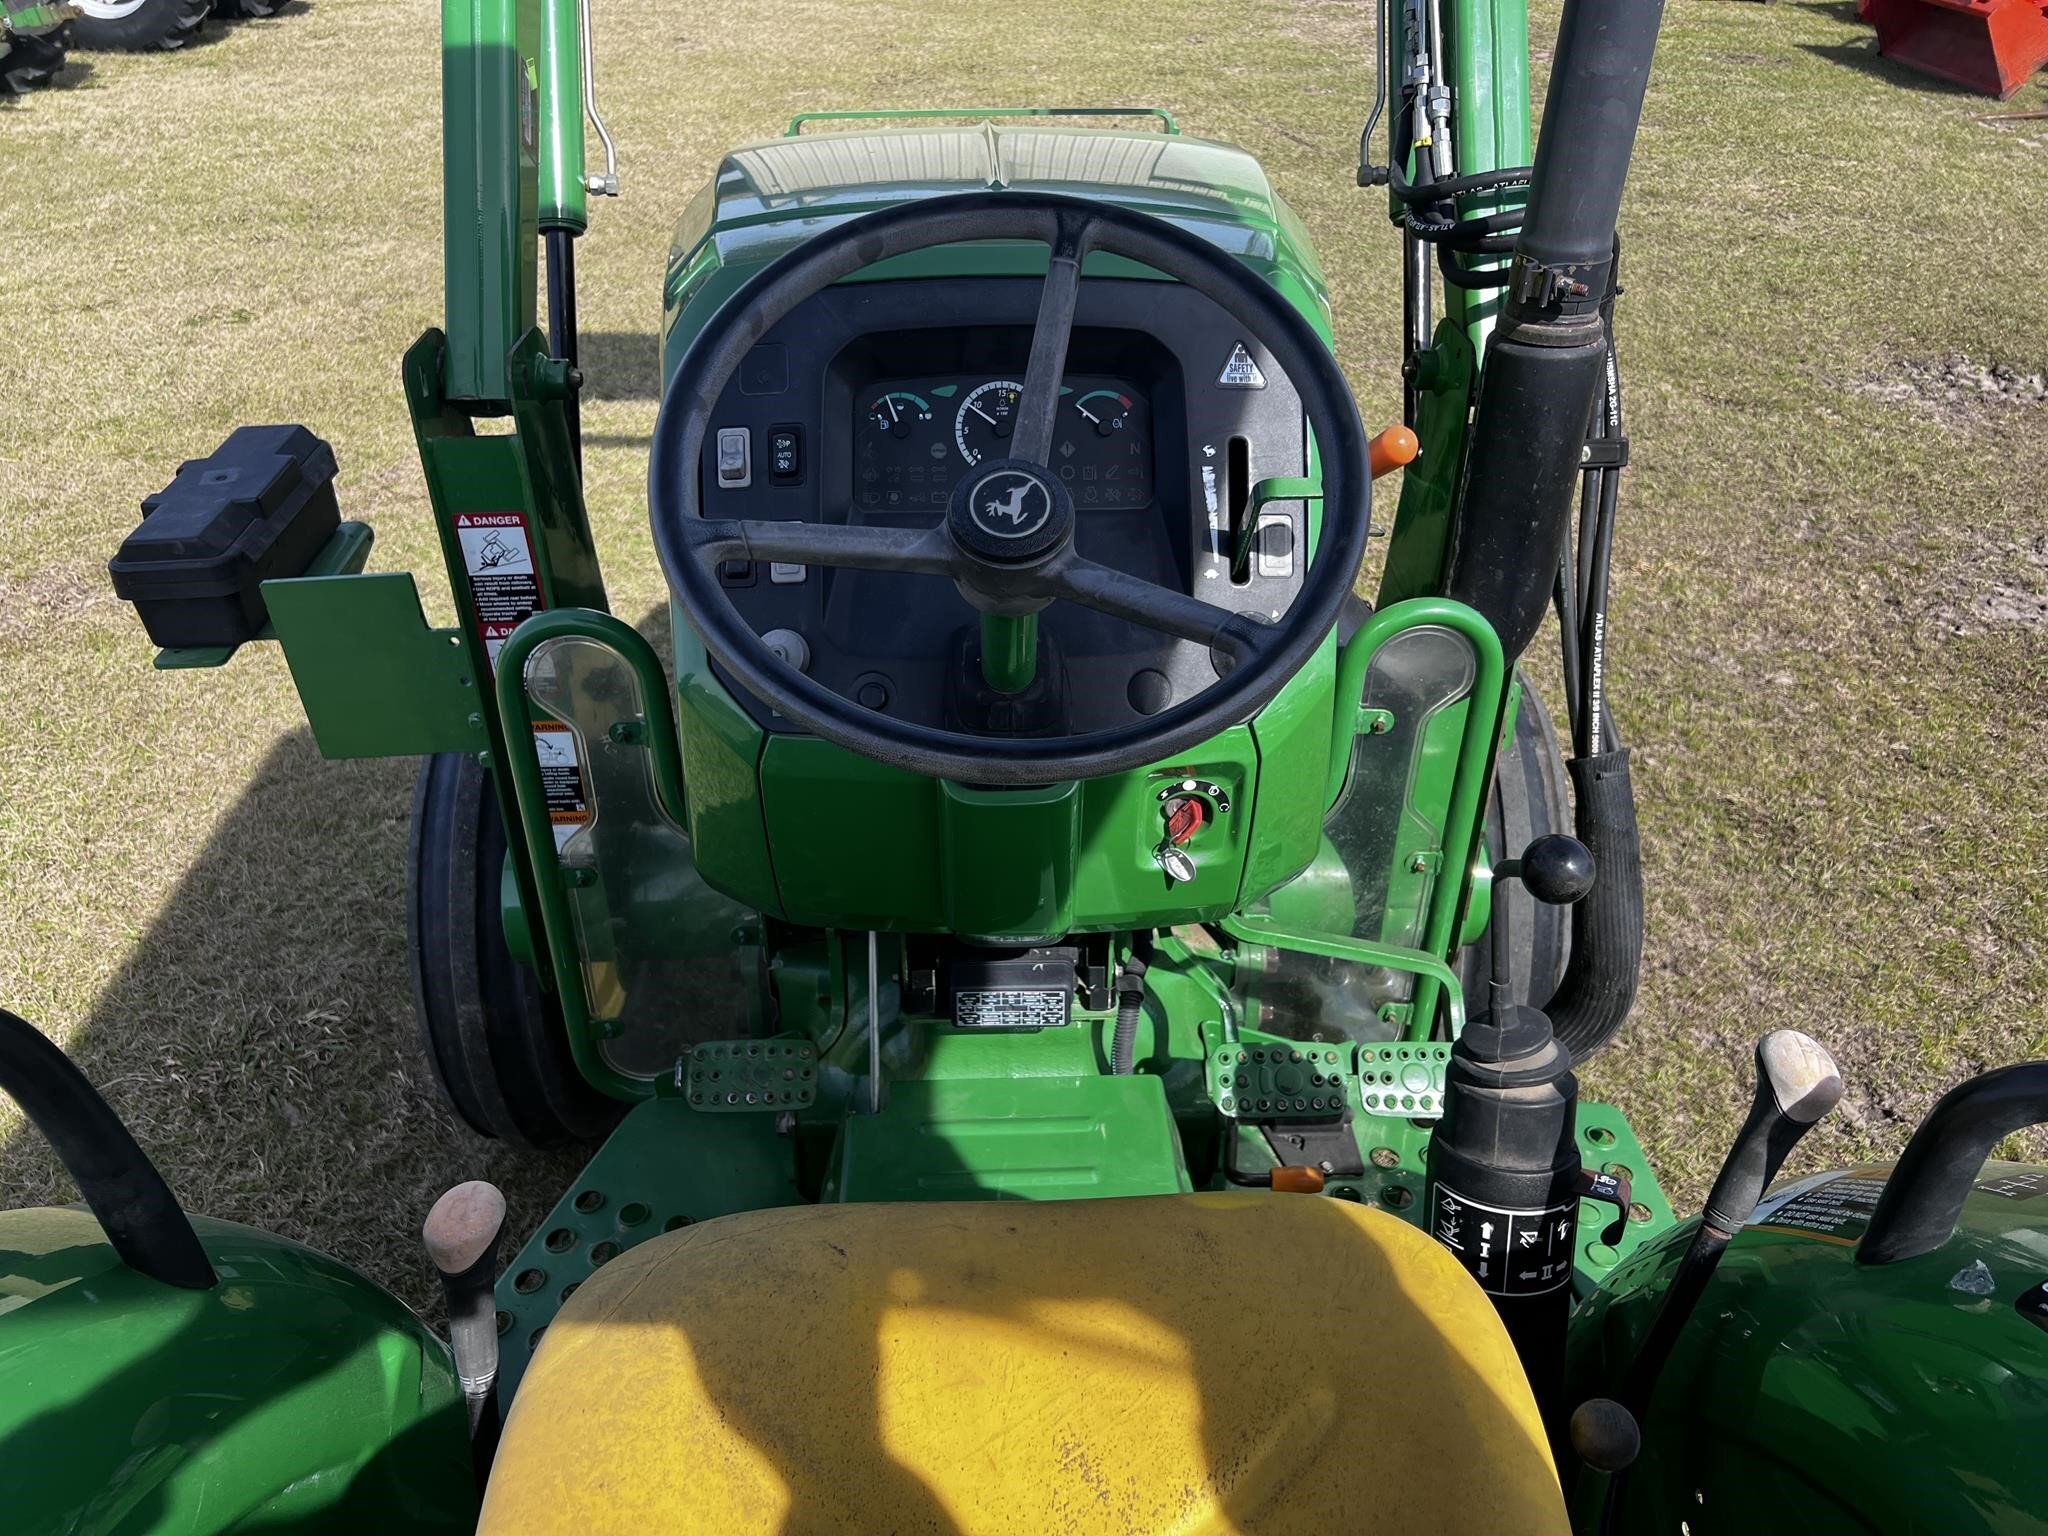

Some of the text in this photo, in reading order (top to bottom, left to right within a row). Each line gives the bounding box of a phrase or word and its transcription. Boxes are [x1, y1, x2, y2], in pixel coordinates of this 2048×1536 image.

[1229, 363, 1254, 373] SAFETY
[998, 389, 1007, 397] 15
[973, 401, 983, 409] 10
[972, 448, 979, 456] 0
[473, 516, 521, 525] DANGER
[1595, 612, 1604, 641] ATLAS
[1593, 646, 1602, 690] ATLAFLEX
[1591, 712, 1600, 734] INCH
